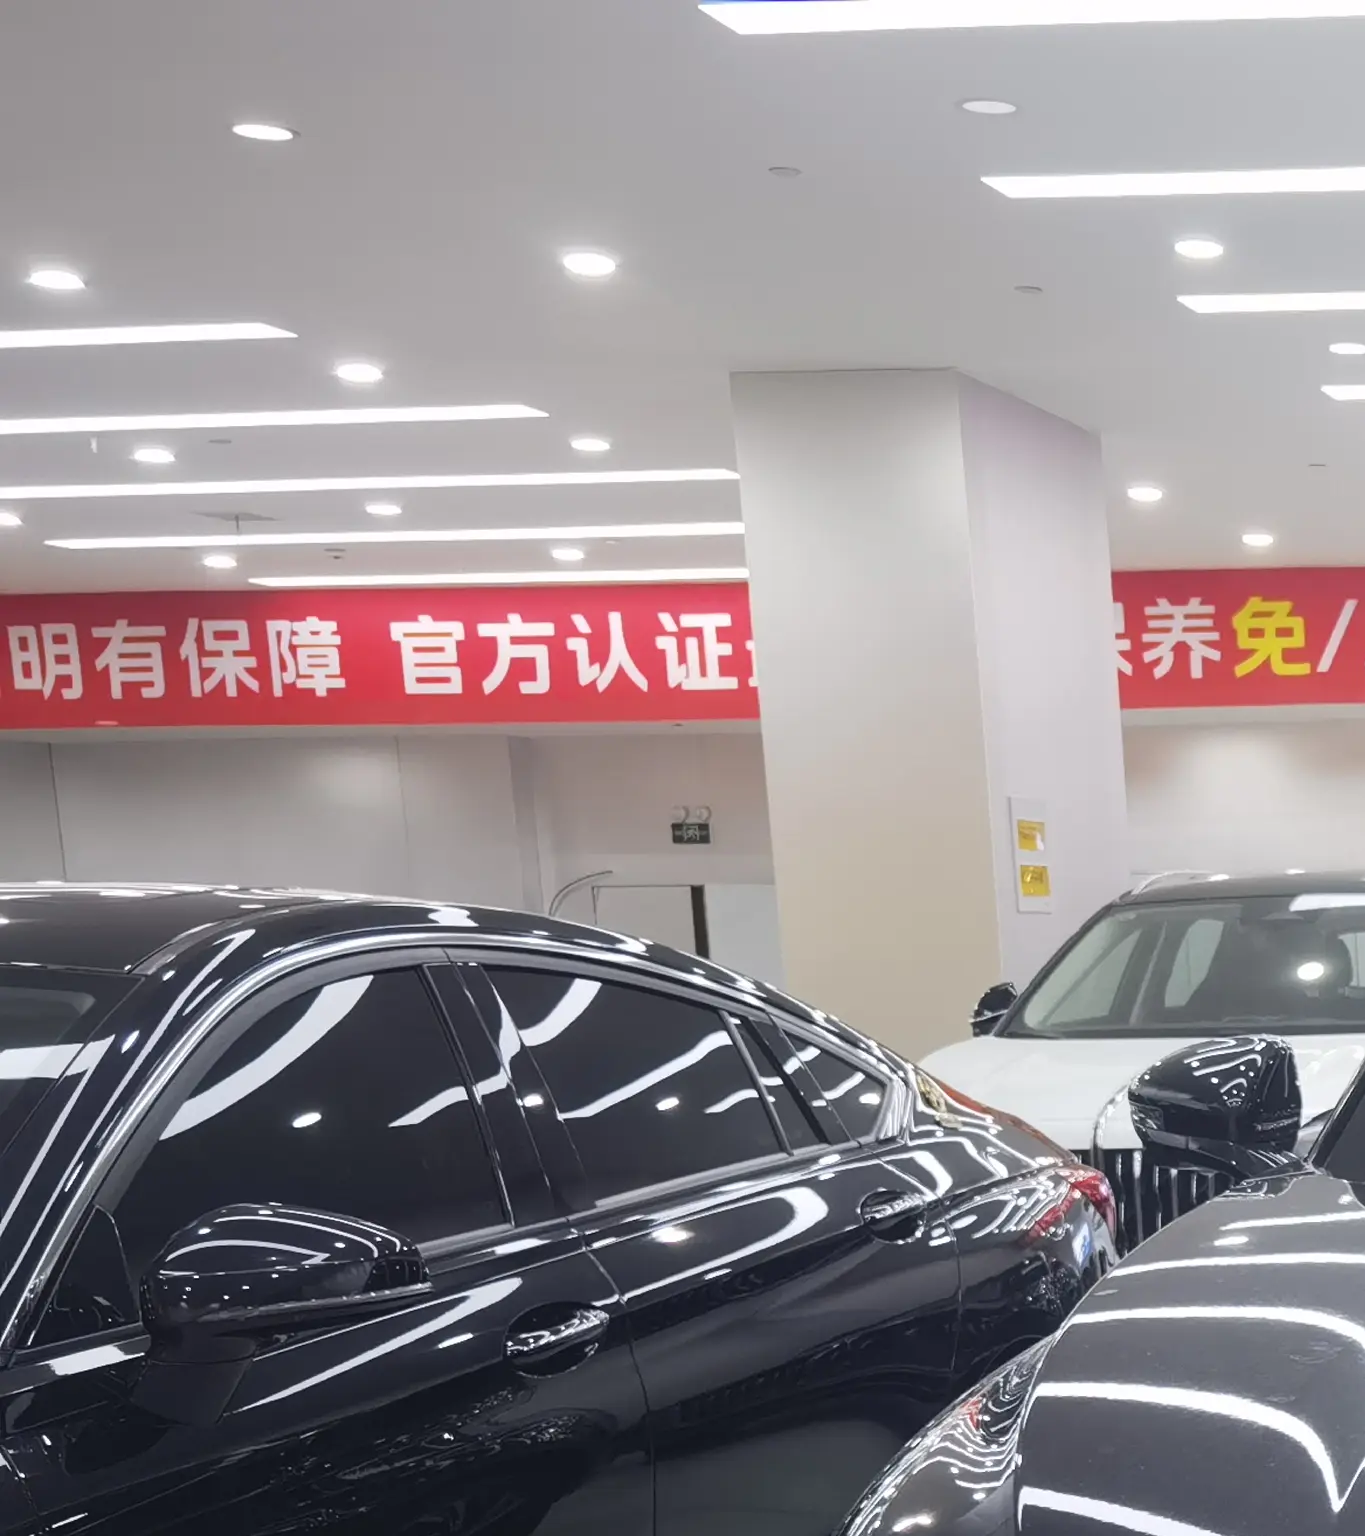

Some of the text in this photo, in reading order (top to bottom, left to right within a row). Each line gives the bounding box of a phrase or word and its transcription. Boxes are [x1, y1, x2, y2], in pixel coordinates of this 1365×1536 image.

[6, 611, 759, 701] 明有保障 官方认证
